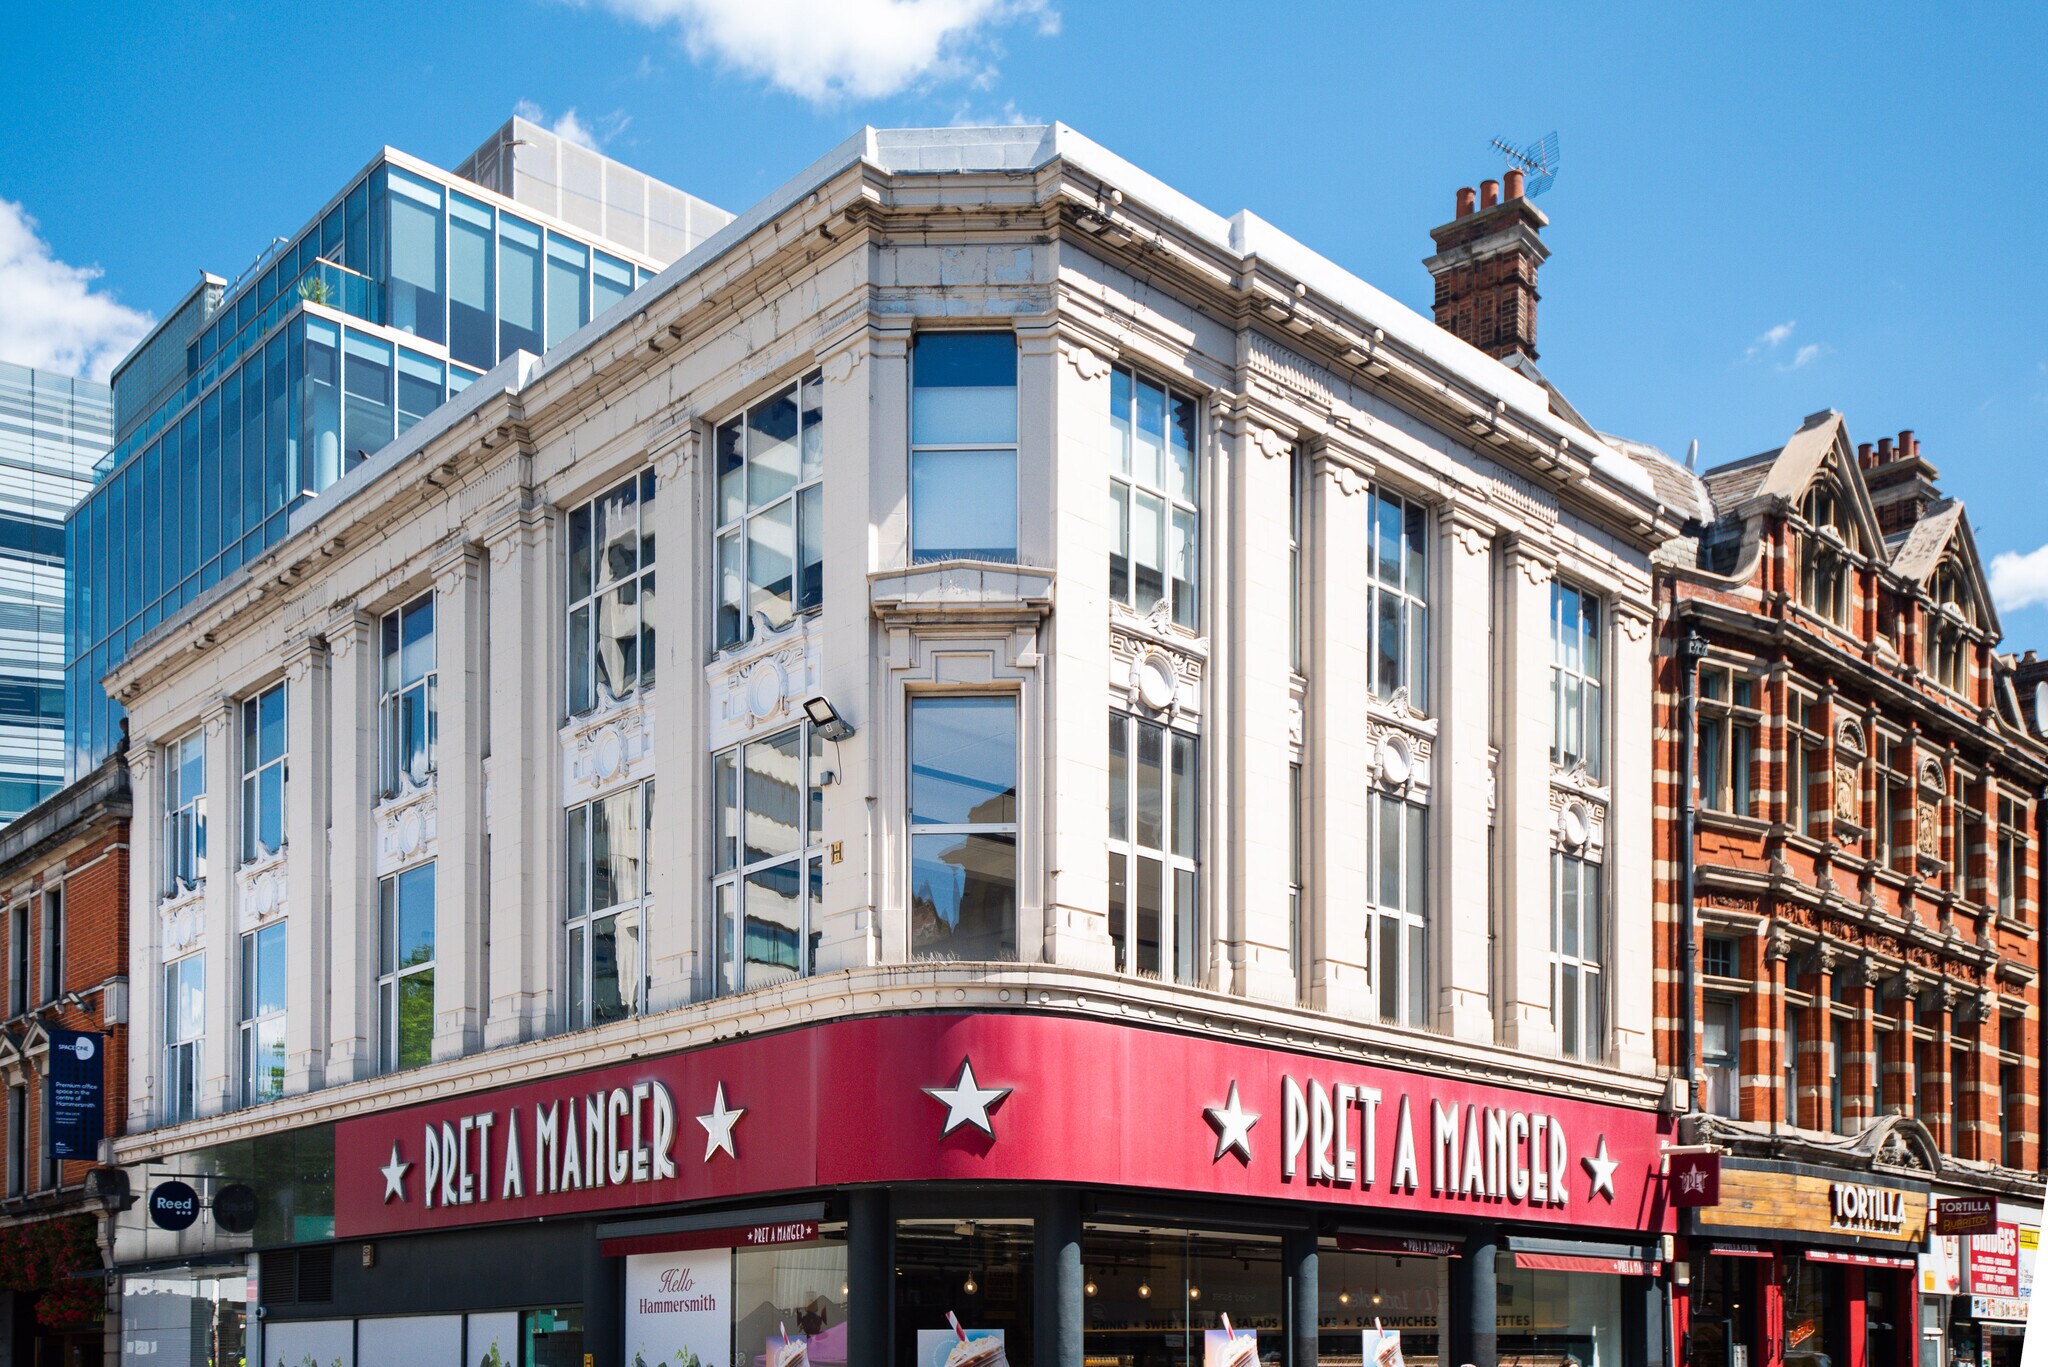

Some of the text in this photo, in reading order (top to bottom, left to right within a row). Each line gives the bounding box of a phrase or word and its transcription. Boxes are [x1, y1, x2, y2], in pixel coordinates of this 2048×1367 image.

[55, 1100, 96, 1108] Hammersmith
[425, 1080, 678, 1209] PRET A MANGER
[1281, 1074, 1569, 1204] PRET A MANGER
[1681, 1171, 1706, 1190] PRET
[157, 1197, 192, 1210] Reed
[1833, 1183, 1907, 1224] TORTILLA
[1940, 1201, 1991, 1212] TORTILLA
[754, 1223, 805, 1243] PRET A MANGER
[1617, 1260, 1629, 1273] PRET
[658, 1268, 696, 1293] Hello
[639, 1294, 716, 1314] Hammersmith
[1092, 1319, 1128, 1330] DRINKS
[1236, 1318, 1278, 1328] SALADS
[1356, 1316, 1437, 1327] SADWICHES
